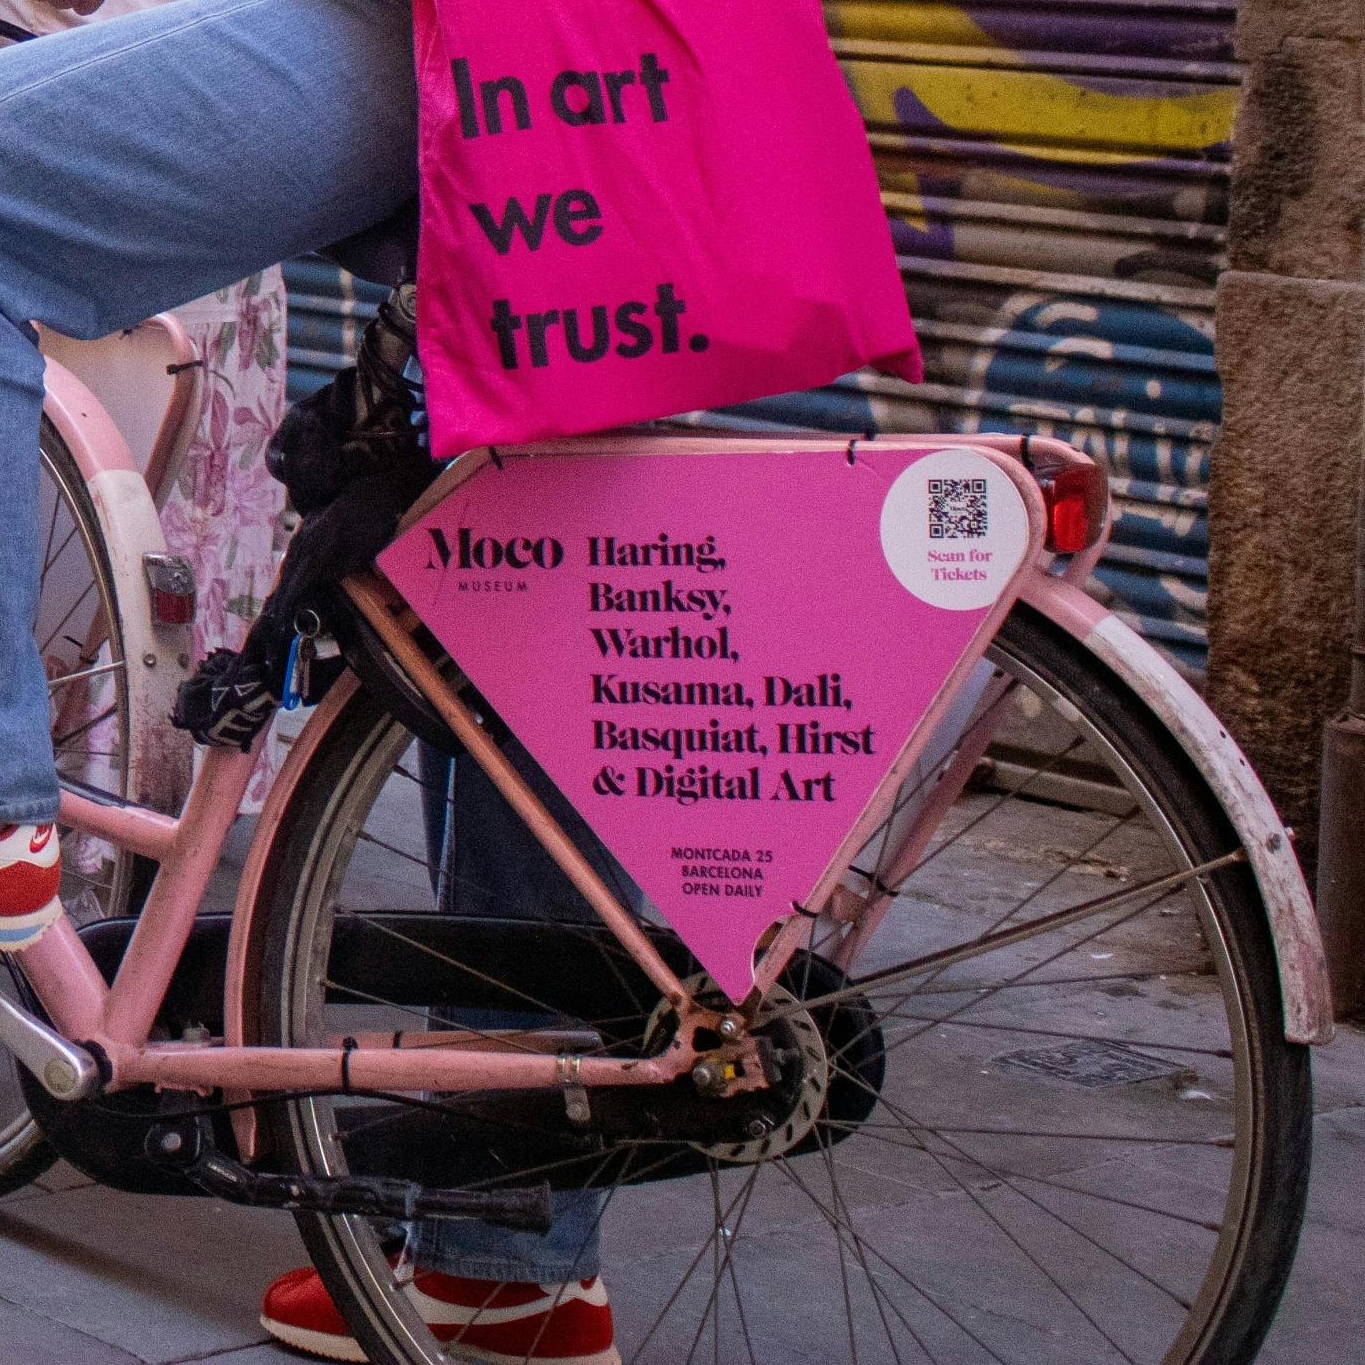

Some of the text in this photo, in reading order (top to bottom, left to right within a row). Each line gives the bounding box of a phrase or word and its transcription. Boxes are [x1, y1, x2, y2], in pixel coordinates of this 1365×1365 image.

[450, 53, 670, 139] In art
[468, 189, 602, 256] we
[489, 283, 710, 371] trust.
[425, 527, 564, 569] Moco
[588, 533, 726, 573] Haring,
[927, 549, 994, 562] Scan for
[458, 581, 528, 592] MUSEUM
[931, 567, 988, 581] Tickets
[589, 580, 732, 620] Banksy,
[591, 626, 739, 663] Warhol,
[591, 672, 854, 710] Kusama, Dali,
[593, 719, 875, 760] Basquiat, Hirst
[592, 766, 836, 806] & Digital Art
[671, 847, 774, 863] MONTCADA 25
[682, 865, 764, 880] BARCELONA
[682, 882, 763, 898] OPEN DAILY
